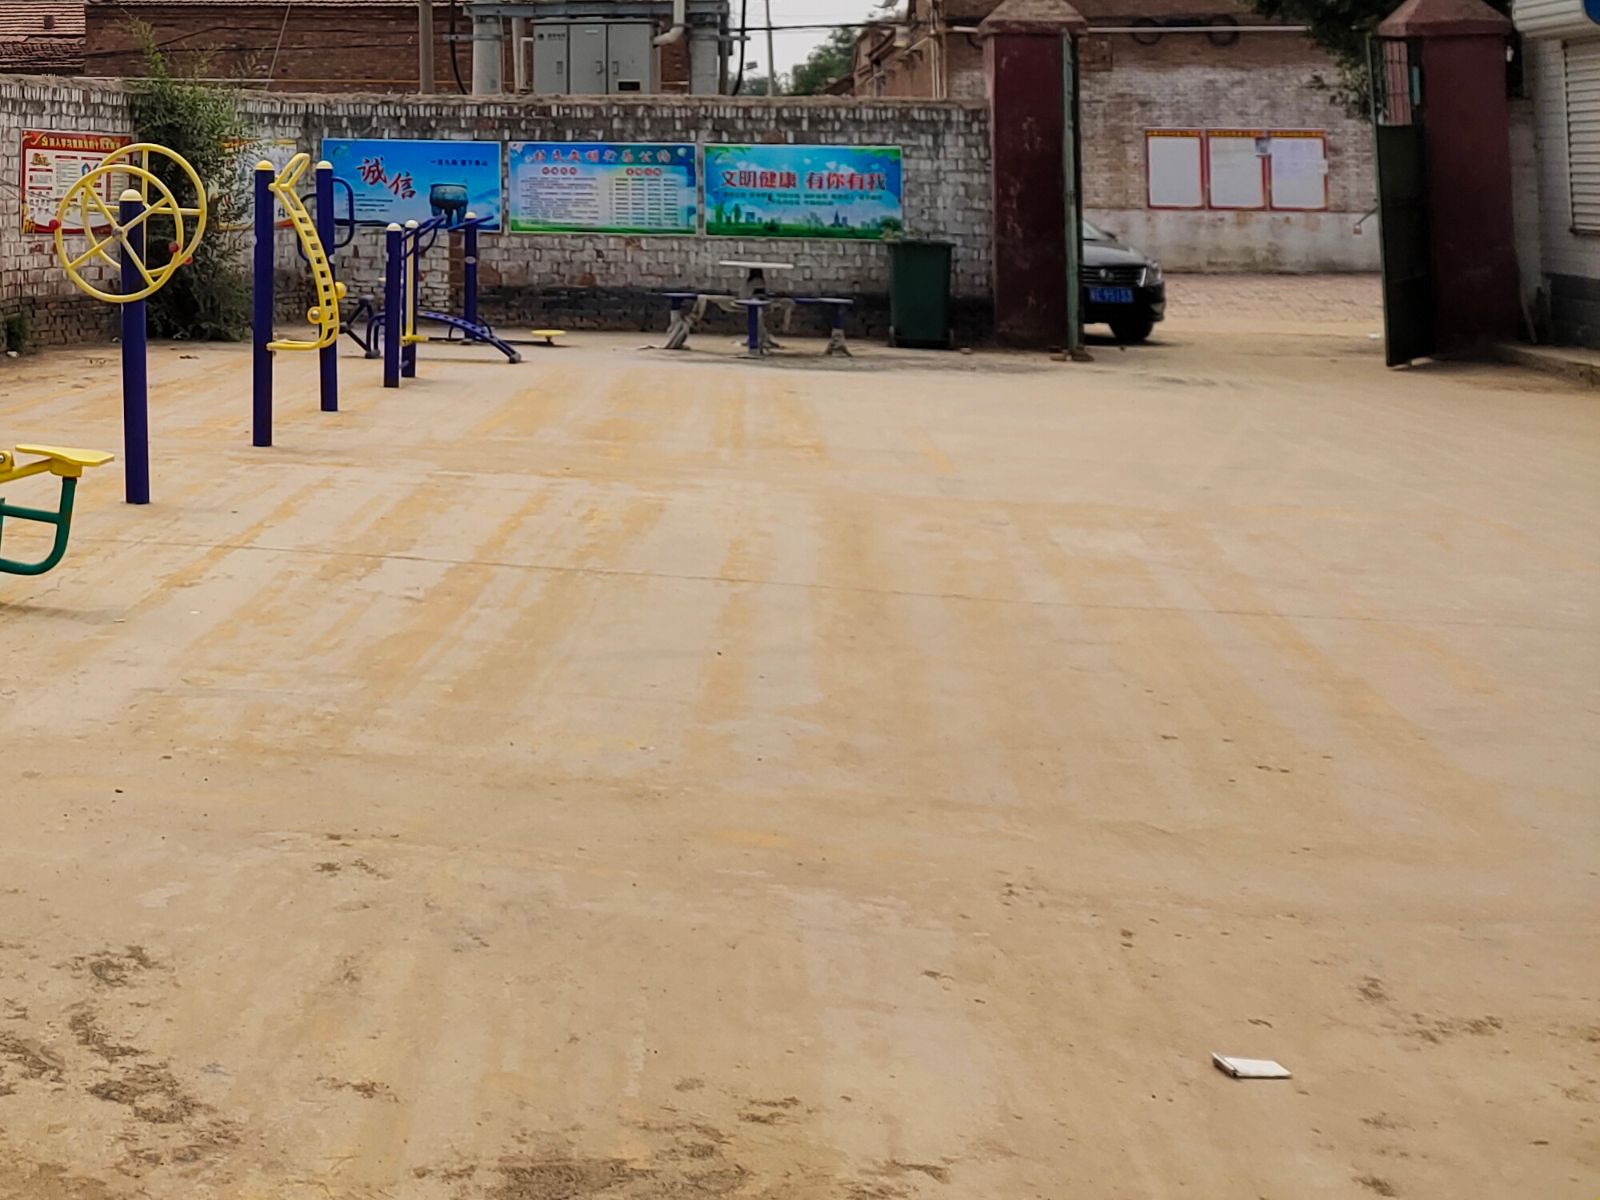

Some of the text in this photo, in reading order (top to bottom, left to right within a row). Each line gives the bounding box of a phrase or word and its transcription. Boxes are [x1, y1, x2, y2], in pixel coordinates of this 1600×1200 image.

[356, 156, 417, 200] 诚信
[720, 170, 887, 191] 文明健康 有你有我
